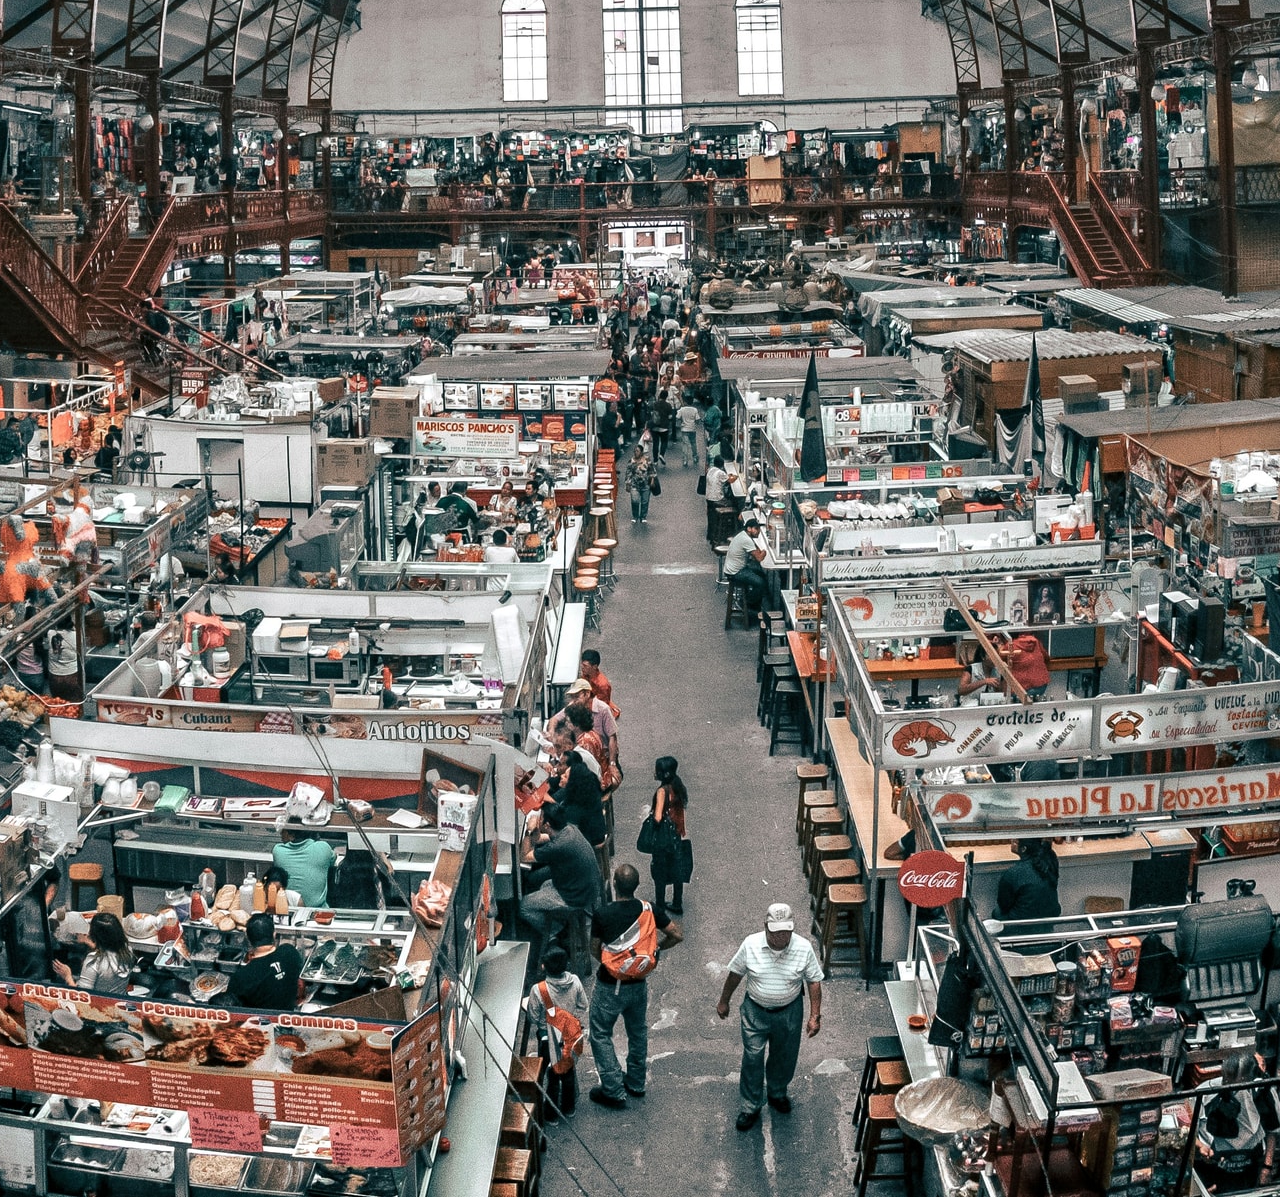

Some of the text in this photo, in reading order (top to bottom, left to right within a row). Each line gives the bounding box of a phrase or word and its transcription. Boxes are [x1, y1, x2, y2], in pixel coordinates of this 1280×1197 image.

[416, 421, 514, 434] MARISCOS PANCHO'S
[1264, 527, 1272, 536] DE
[1234, 538, 1252, 547] SOPA
[1255, 537, 1263, 546] DE
[1257, 546, 1264, 554] DE
[970, 552, 1002, 567] Dulce
[1004, 552, 1028, 564] vida
[826, 562, 859, 574] Dulce
[861, 562, 885, 573] vida
[182, 712, 232, 724] Cubana
[986, 711, 1044, 726] Cocteles
[1227, 706, 1269, 721] tostadas
[368, 718, 471, 743] Antojitos
[1051, 723, 1077, 750] CARACOL
[1165, 719, 1219, 741] Especialidad
[956, 726, 984, 755] CAMARON
[972, 731, 996, 754] OSTION
[1004, 730, 1025, 752] PULPO
[1035, 729, 1054, 751] JAIBA
[900, 869, 960, 888] Coca-Cola
[23, 982, 92, 1004] FILETES
[142, 1001, 231, 1023] PECHUGAS
[278, 1014, 359, 1033] COMIDAS
[152, 1082, 176, 1091] Queso
[152, 1089, 176, 1097] Queso
[283, 1083, 332, 1092] Chile relleno
[283, 1089, 306, 1097] Carne
[283, 1096, 317, 1105] Pechuga
[360, 1090, 380, 1098] Mole
[285, 1102, 356, 1115] Milanesa pollo-res
[285, 1109, 308, 1117] Carne
[309, 1110, 319, 1118] de
[320, 1112, 347, 1122] puerco
